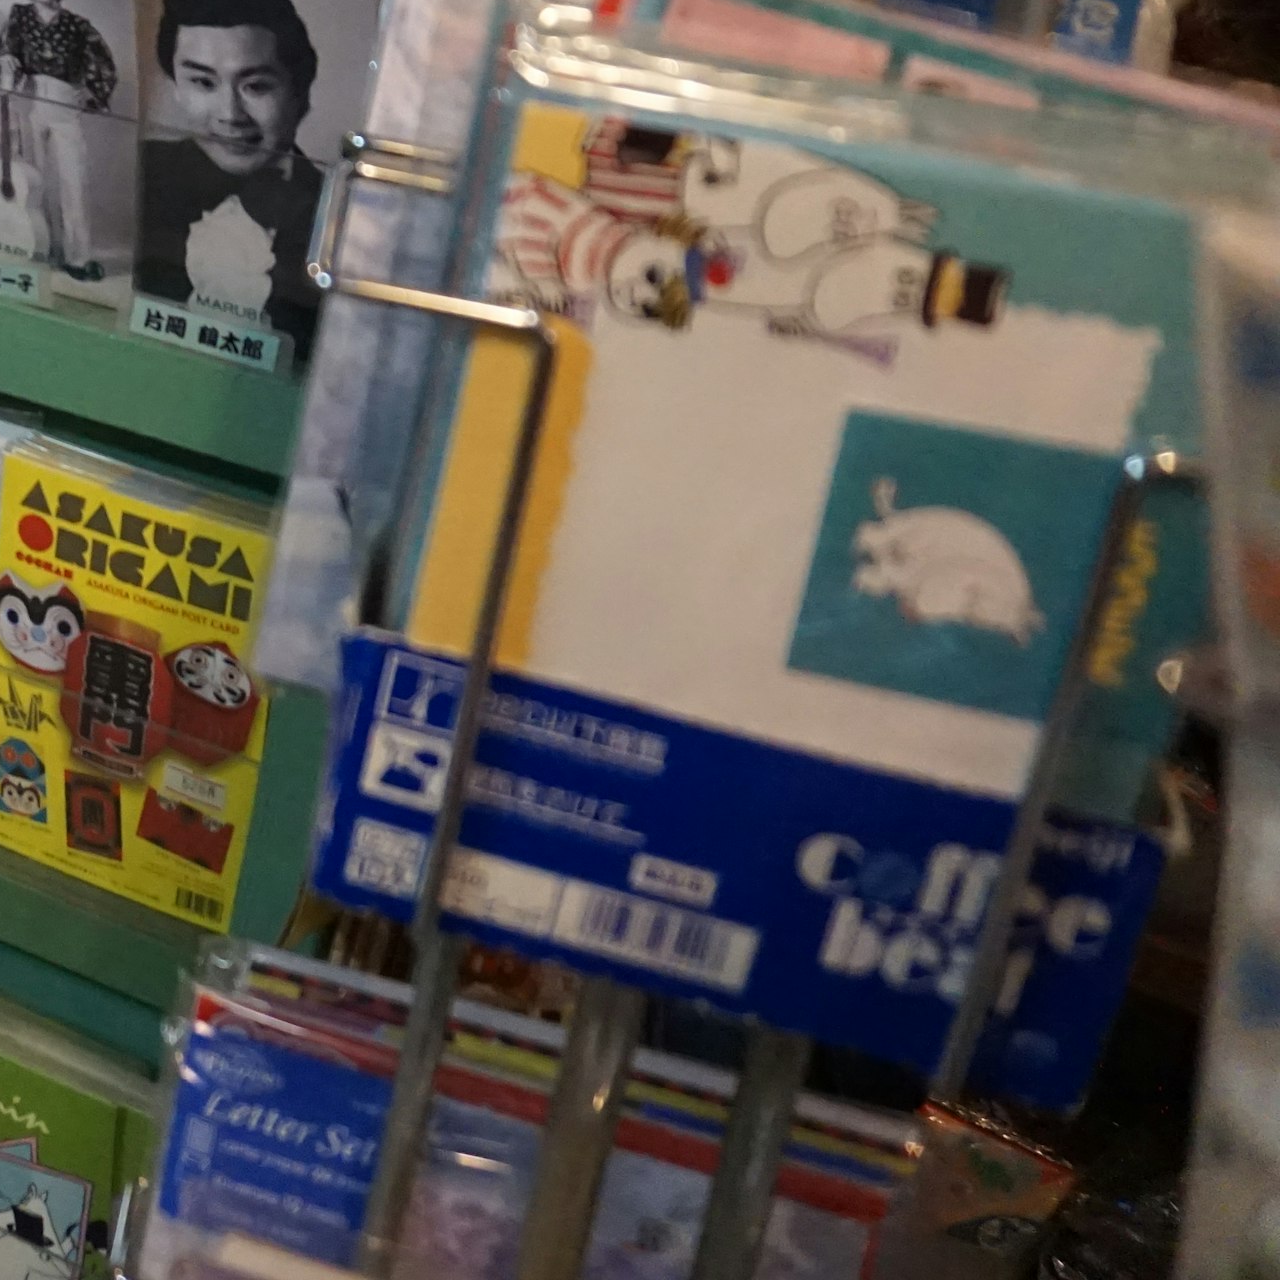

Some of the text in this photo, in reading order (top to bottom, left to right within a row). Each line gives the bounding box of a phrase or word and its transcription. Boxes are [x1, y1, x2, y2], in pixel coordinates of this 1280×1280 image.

[18, 514, 253, 622] ORIGAMI
[21, 480, 255, 583] ASAKUSA
[86, 578, 130, 600] ASAKUSA
[181, 608, 208, 626] POST
[210, 617, 241, 635] CARD
[203, 1086, 378, 1167] Letter Set
